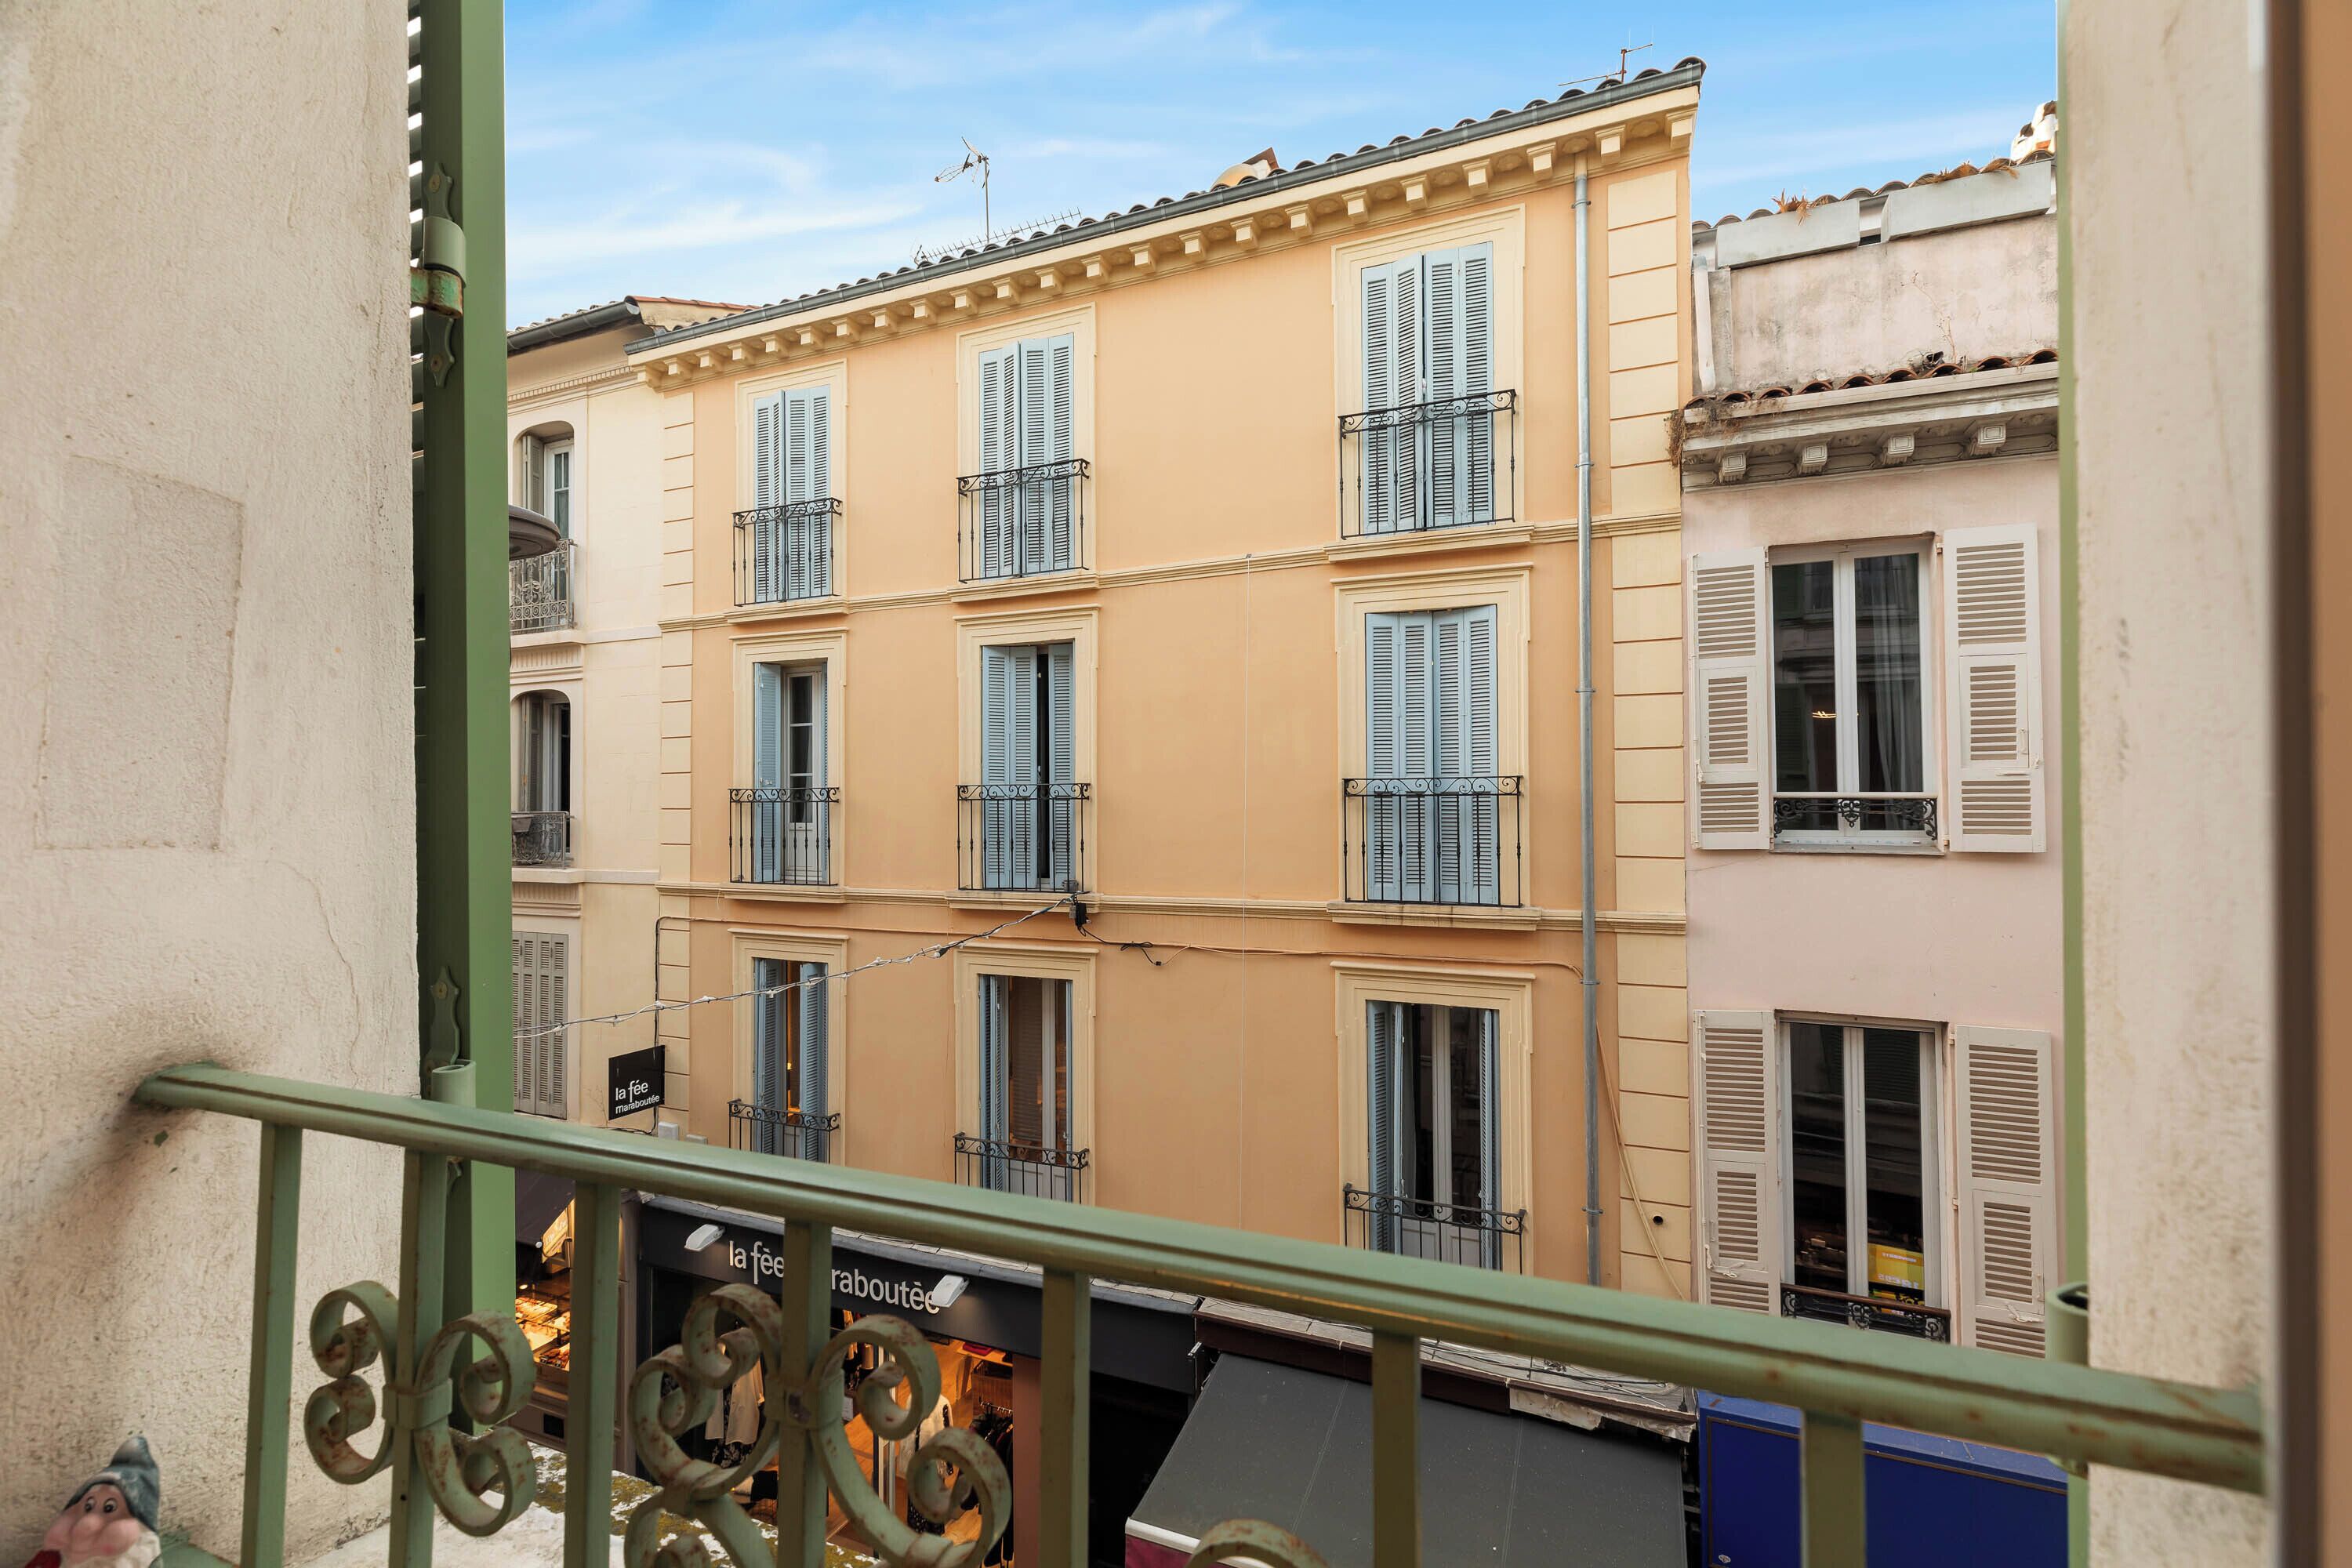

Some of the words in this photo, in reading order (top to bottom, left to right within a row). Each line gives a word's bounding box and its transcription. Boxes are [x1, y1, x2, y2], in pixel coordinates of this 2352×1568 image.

[615, 1087, 626, 1101] la
[627, 1079, 649, 1103] fée
[615, 1094, 660, 1114] maraboutée
[729, 1240, 747, 1269] la
